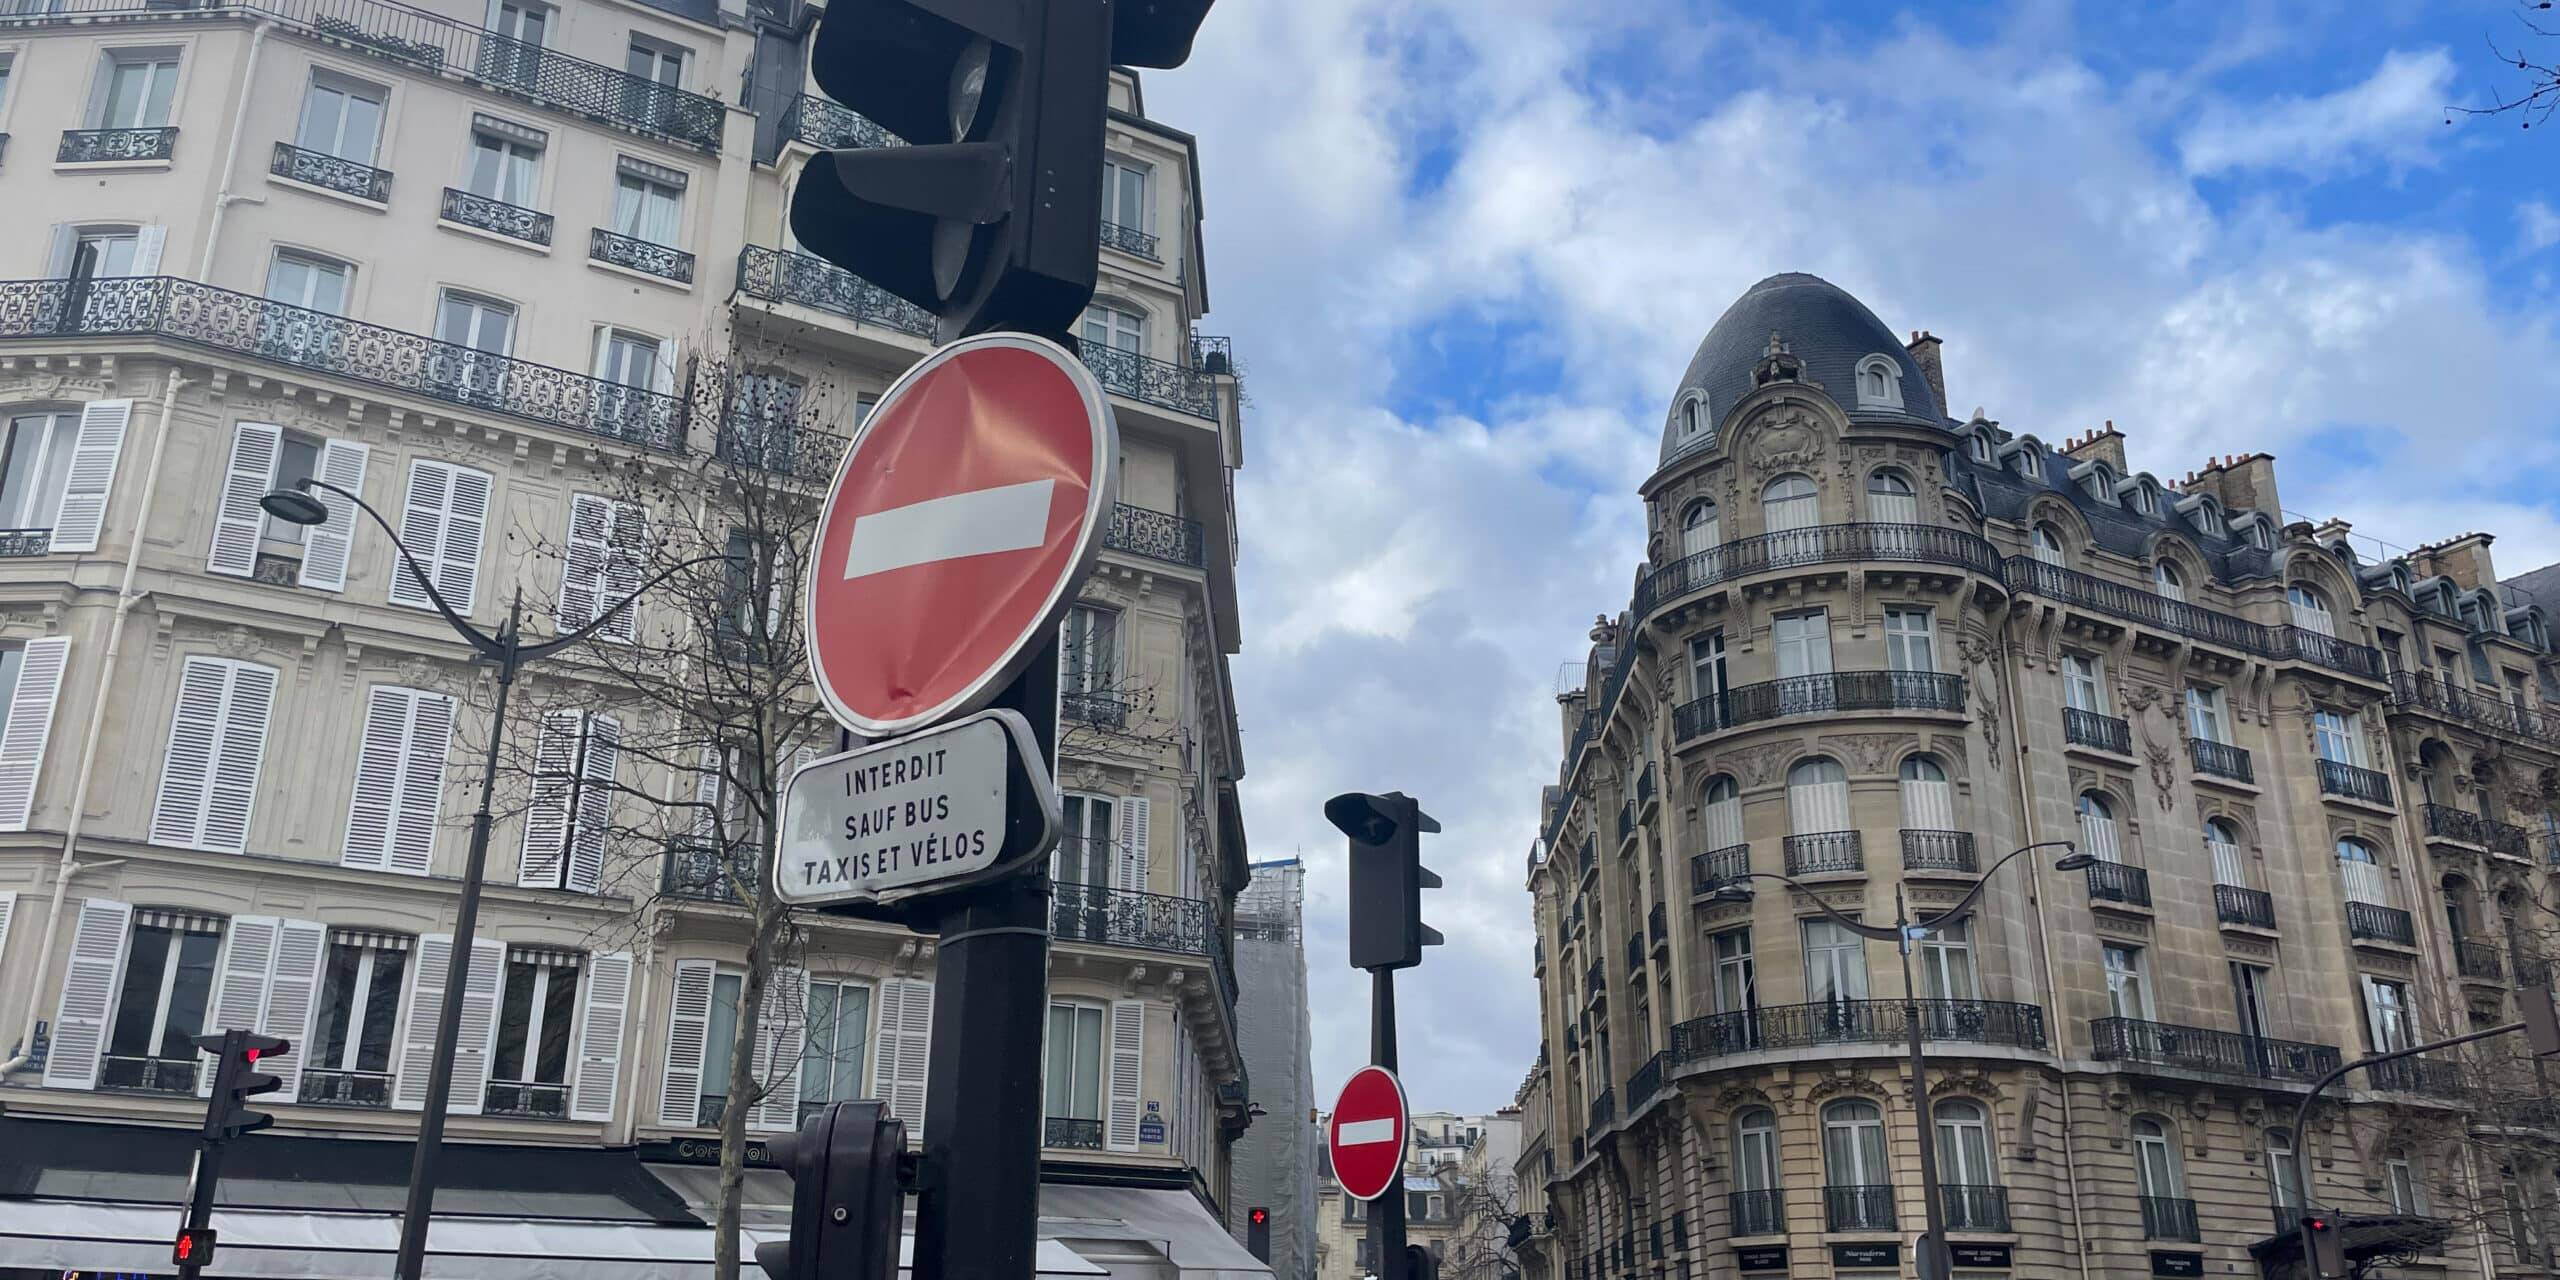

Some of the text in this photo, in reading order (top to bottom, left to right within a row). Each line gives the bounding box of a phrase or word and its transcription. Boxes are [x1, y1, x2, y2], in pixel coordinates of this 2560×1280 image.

[845, 749, 947, 797] INTERDIT
[845, 794, 949, 841] SAUF BUS
[804, 830, 985, 886] TAXIS ET VÉLOS
